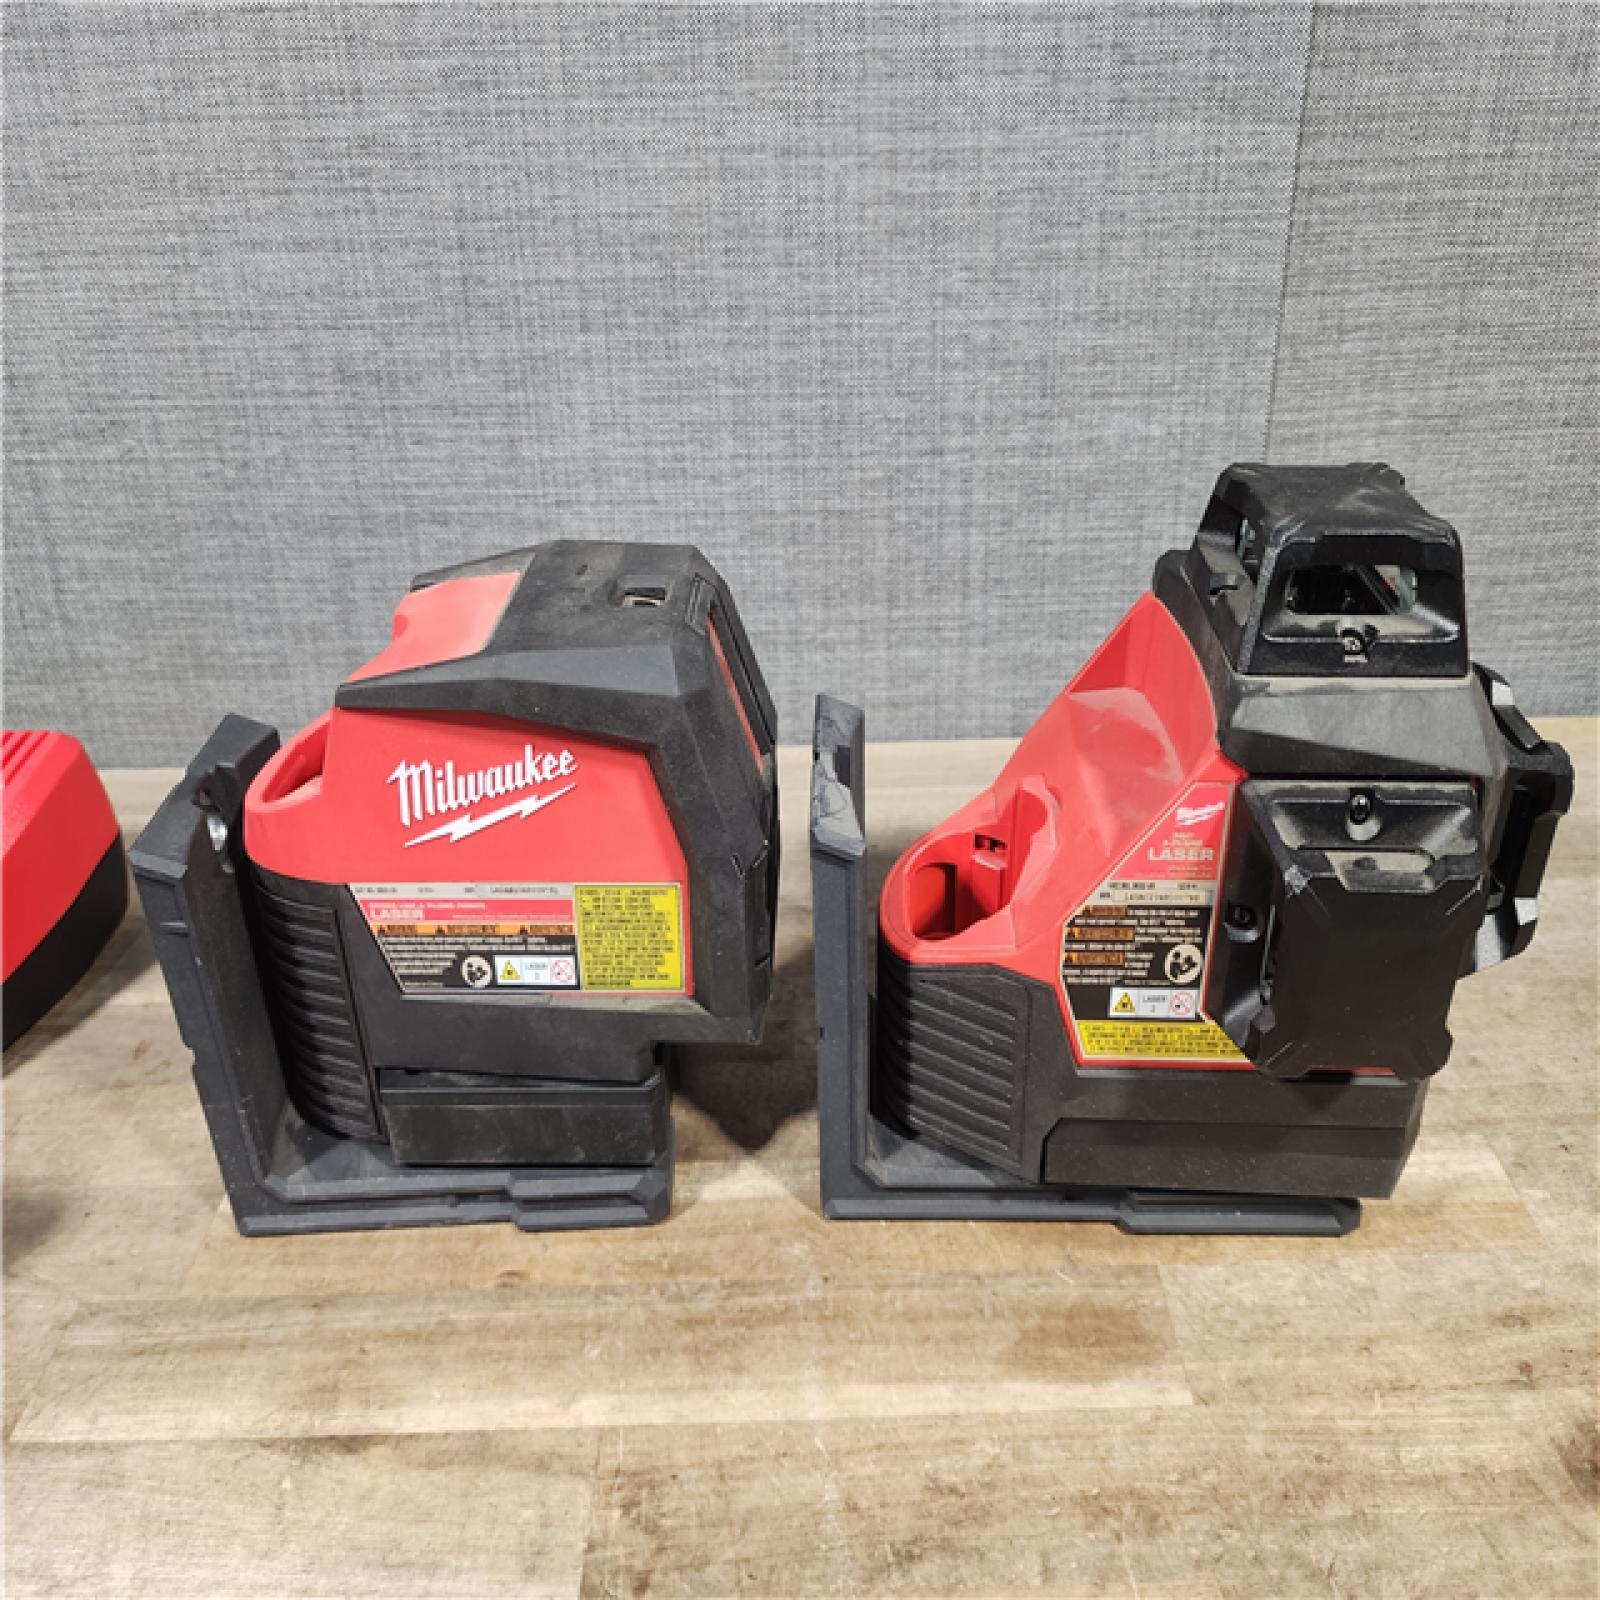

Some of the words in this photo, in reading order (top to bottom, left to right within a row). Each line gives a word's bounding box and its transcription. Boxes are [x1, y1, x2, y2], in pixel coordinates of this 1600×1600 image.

[386, 744, 578, 827] Milwaukee
[1149, 847, 1214, 861] LASER
[370, 908, 424, 920] LASER
